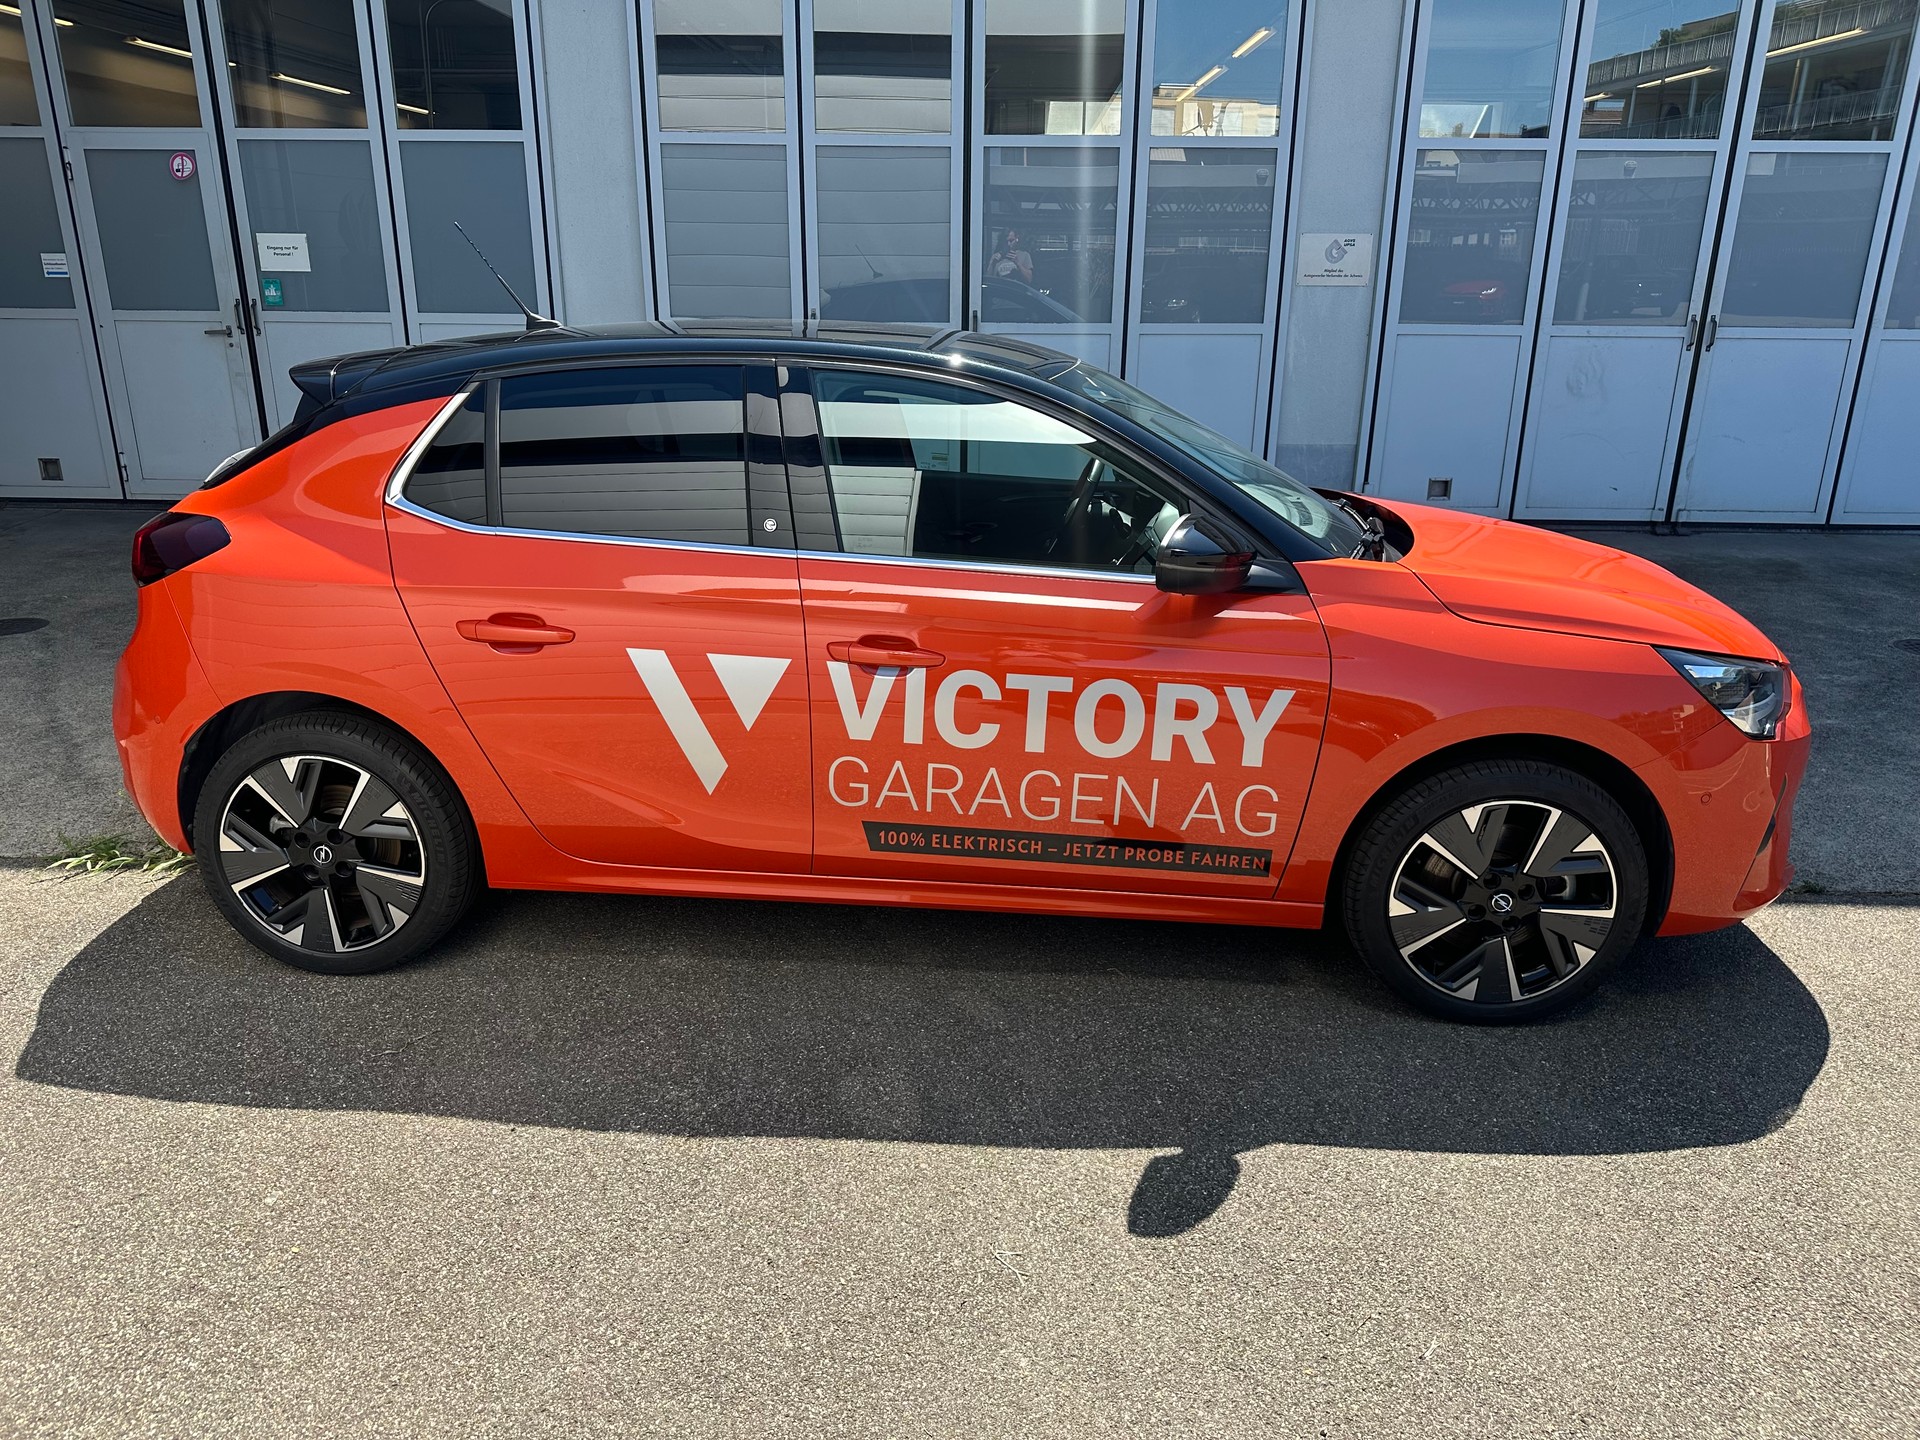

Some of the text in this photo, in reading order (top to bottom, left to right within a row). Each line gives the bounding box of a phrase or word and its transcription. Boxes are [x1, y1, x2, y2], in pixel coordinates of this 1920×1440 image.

[826, 660, 1296, 767] VICTORY
[828, 756, 1279, 837] GARAGEN AG
[879, 830, 925, 847] 100%
[931, 833, 1042, 854] ELEKTRISCH
[1063, 842, 1119, 860] JETZT
[1124, 846, 1184, 864] PROBE
[1191, 852, 1266, 870] FAHREN
